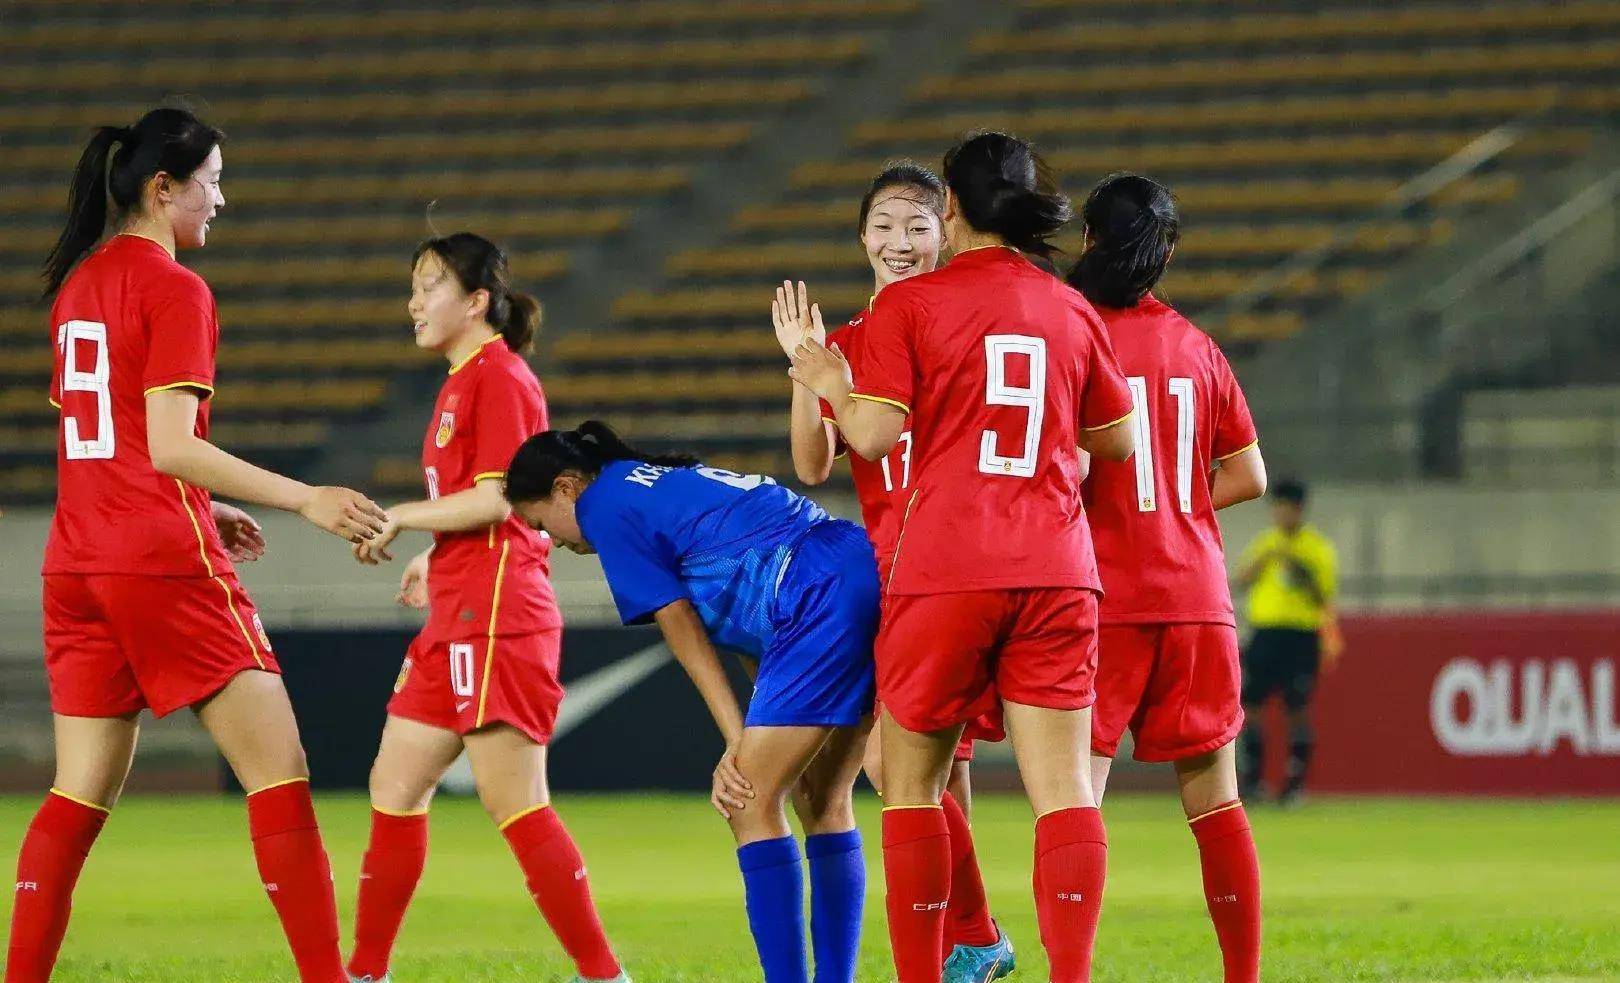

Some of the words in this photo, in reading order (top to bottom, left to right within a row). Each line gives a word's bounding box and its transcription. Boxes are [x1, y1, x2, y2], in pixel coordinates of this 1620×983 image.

[979, 334, 1047, 478] 9
[1126, 376, 1194, 514] 11
[449, 642, 474, 696] 10
[1430, 657, 1620, 757] QUAL
[912, 901, 948, 911] CFA
